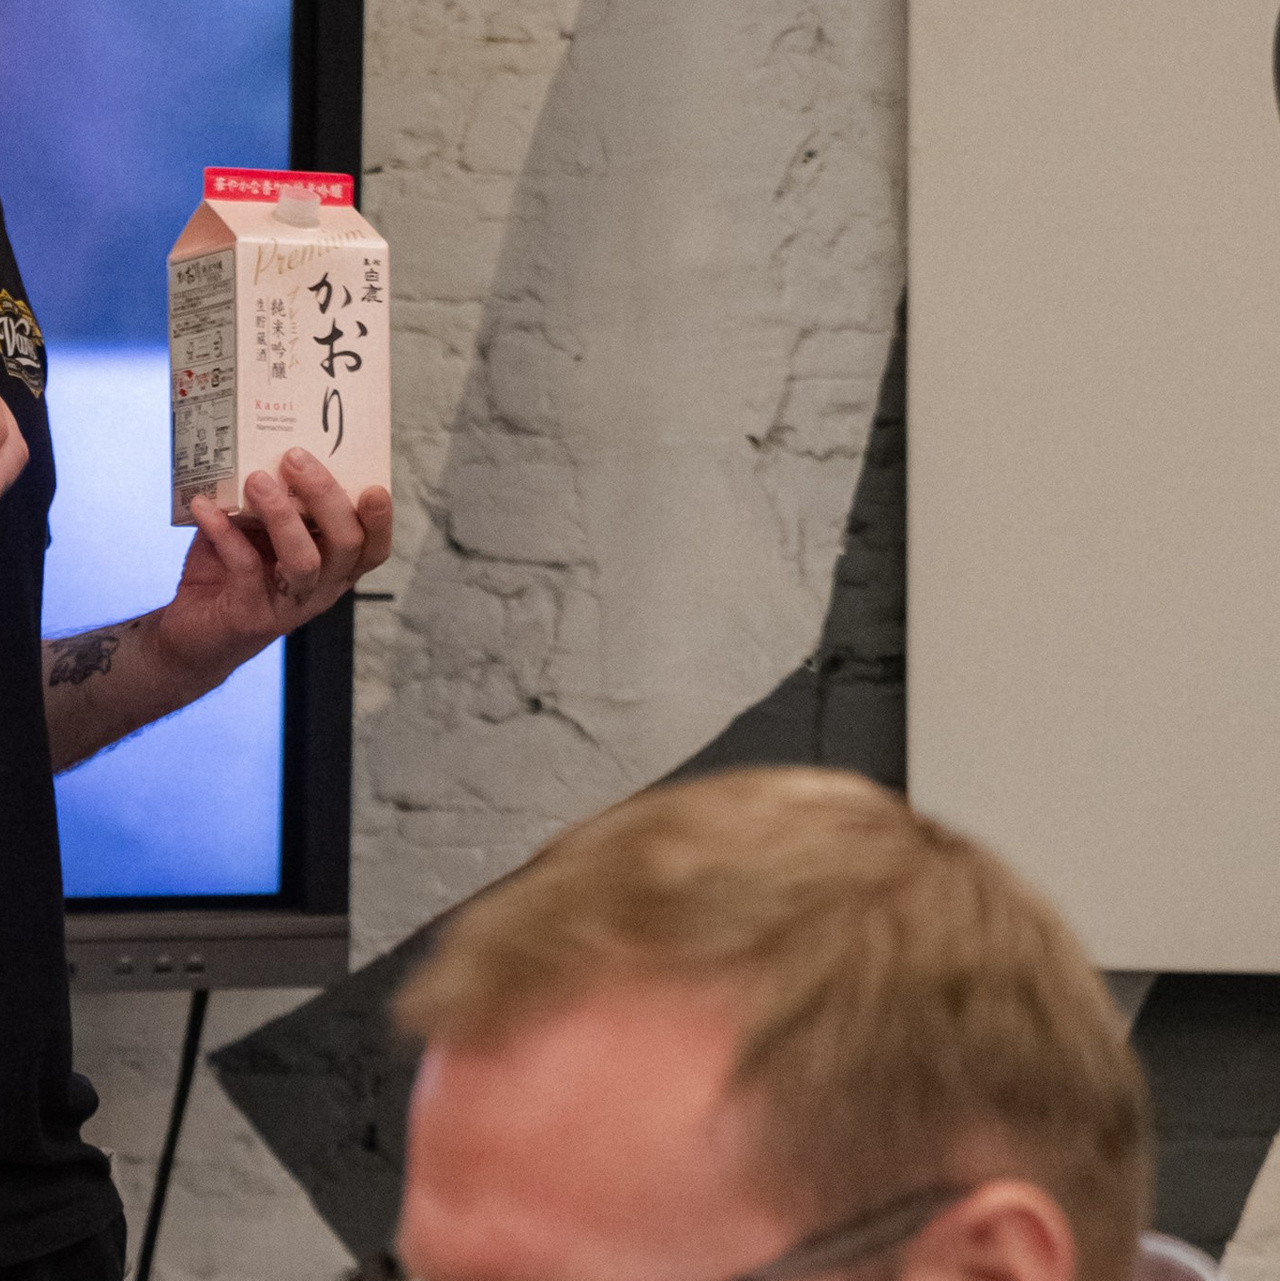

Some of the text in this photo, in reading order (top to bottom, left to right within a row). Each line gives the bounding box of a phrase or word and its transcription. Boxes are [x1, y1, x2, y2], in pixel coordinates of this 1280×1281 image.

[254, 400, 294, 411] Kaori
[306, 272, 369, 458] かおり
